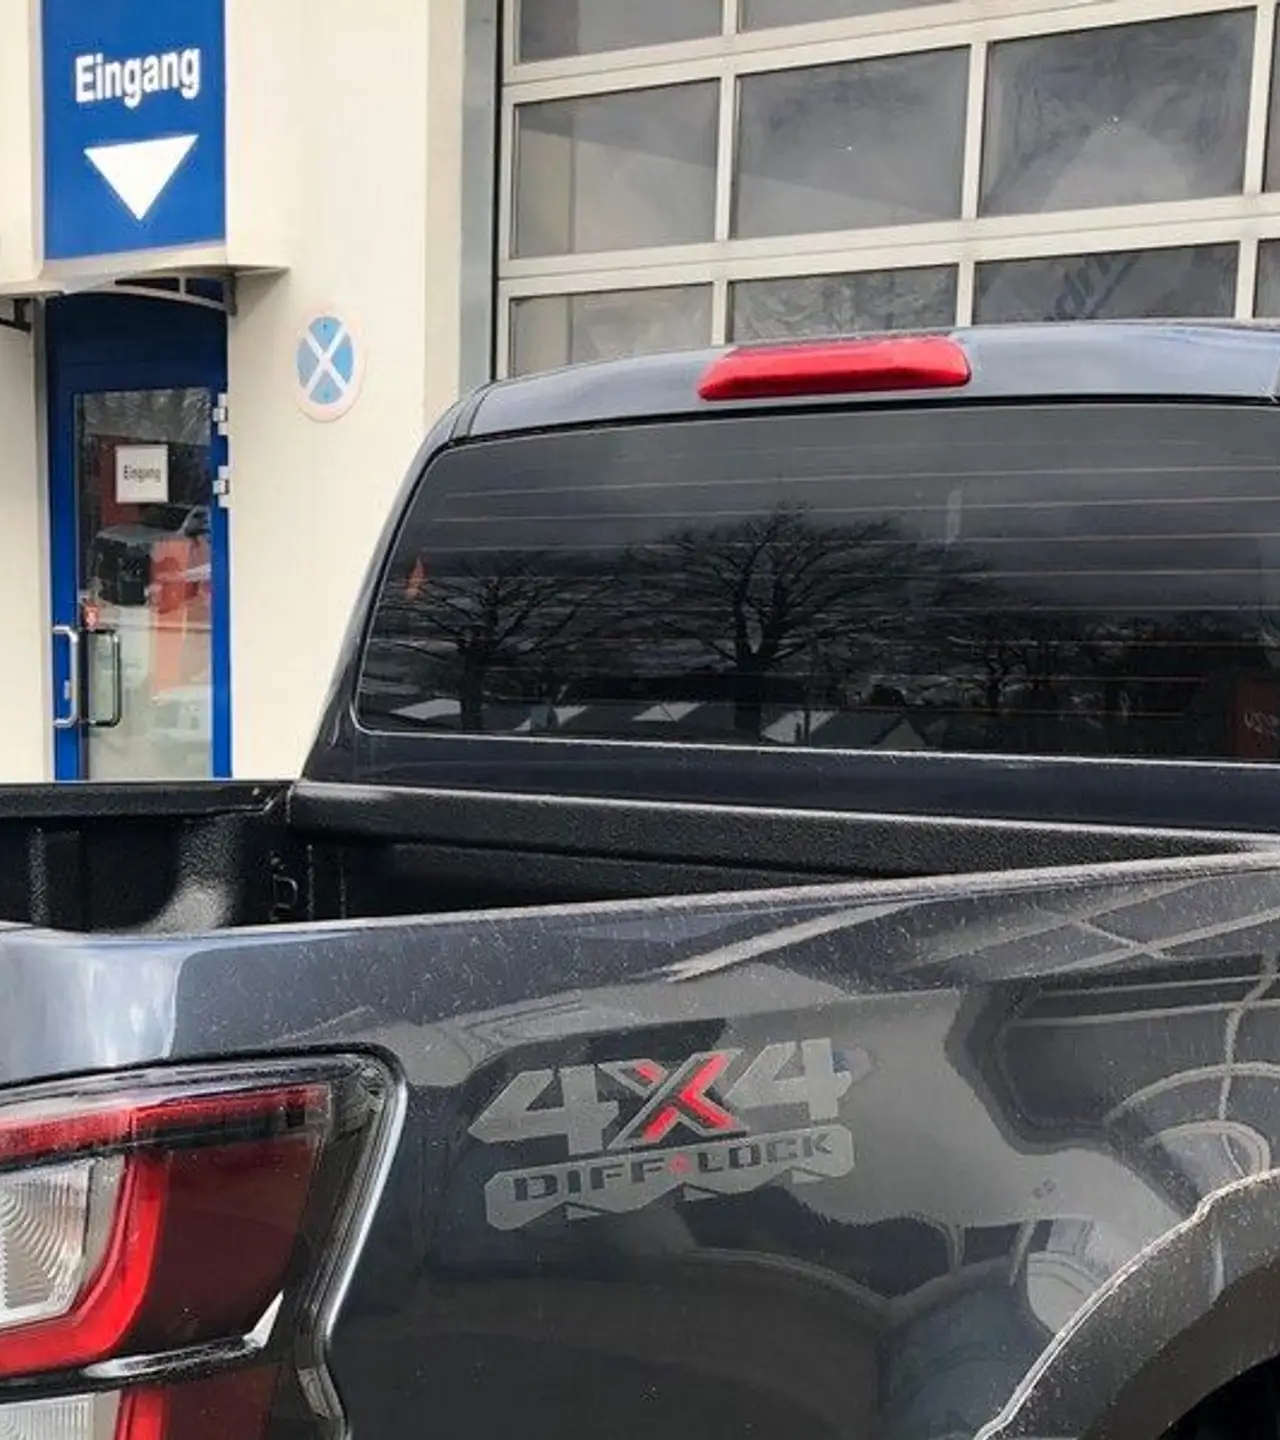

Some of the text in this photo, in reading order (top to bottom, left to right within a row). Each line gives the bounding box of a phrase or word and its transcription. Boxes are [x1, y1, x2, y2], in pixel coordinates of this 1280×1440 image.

[75, 48, 201, 109] Eingang
[514, 1132, 832, 1202] DIFF LOCK
